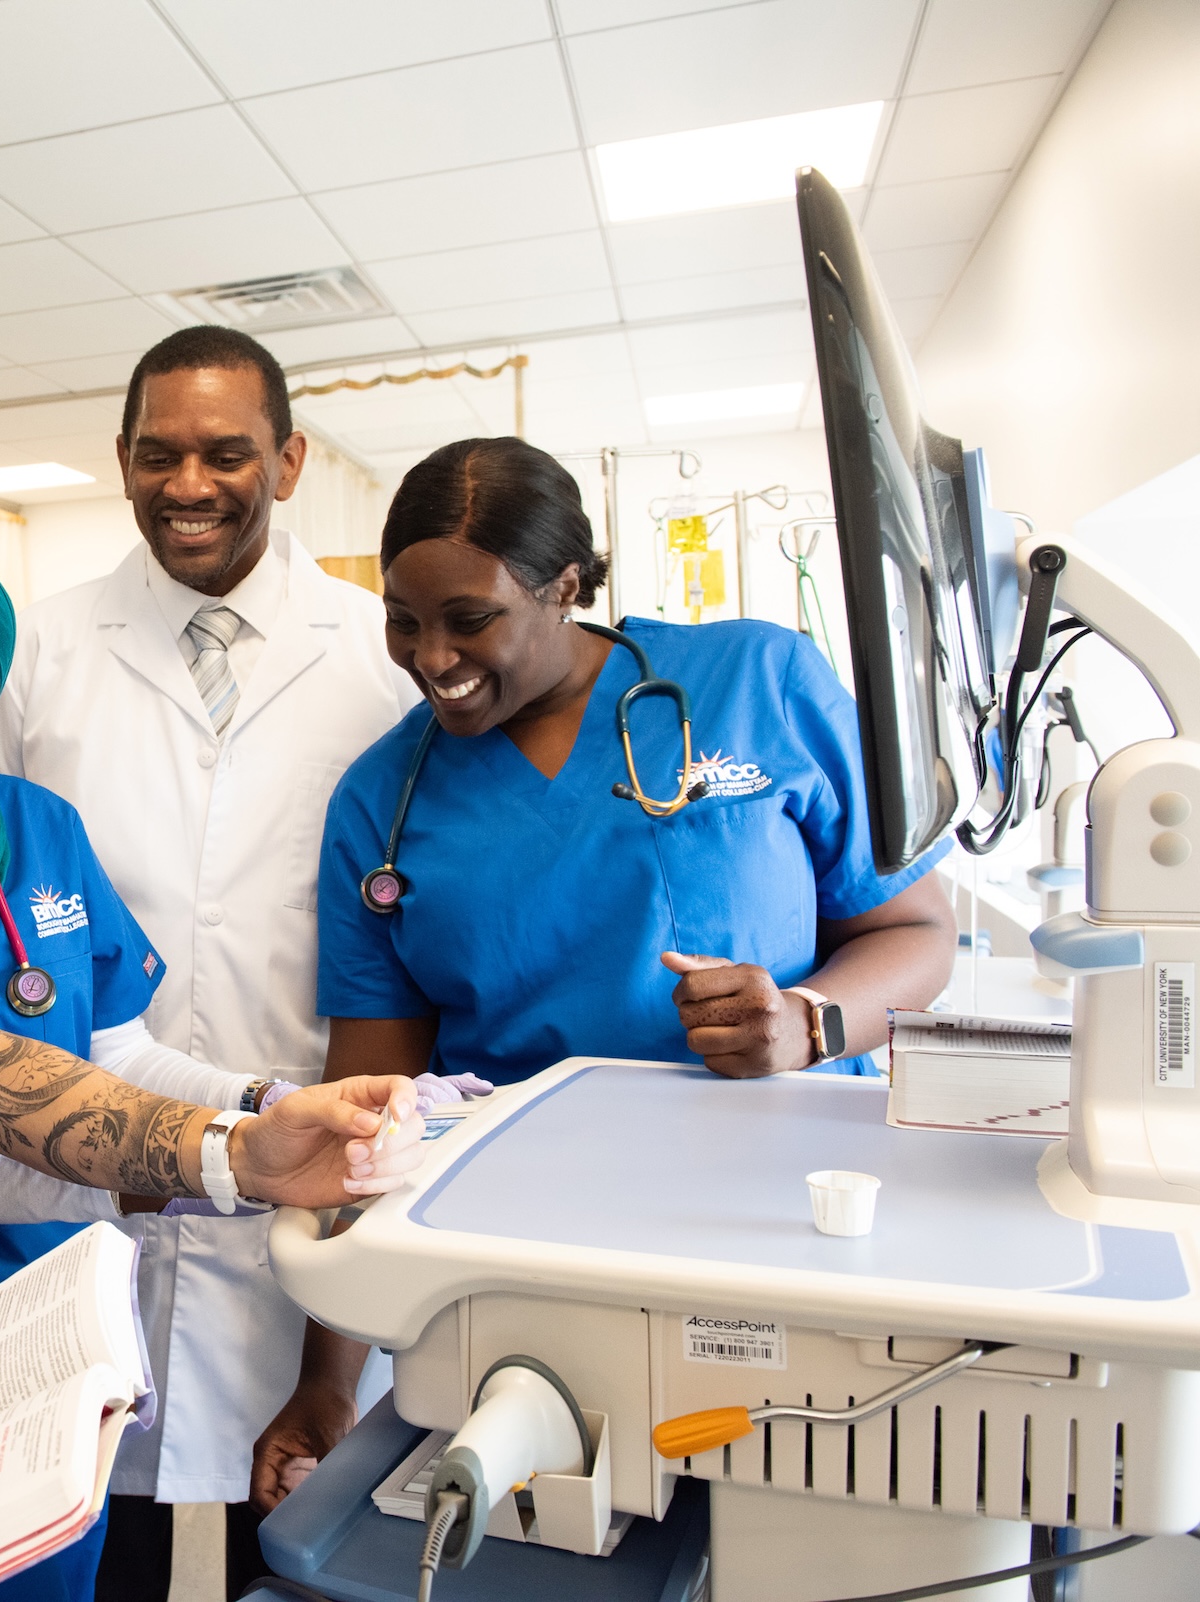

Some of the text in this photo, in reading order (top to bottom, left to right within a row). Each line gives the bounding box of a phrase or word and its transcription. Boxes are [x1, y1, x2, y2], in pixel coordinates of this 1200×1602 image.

[1159, 968, 1168, 1081] CITY UNIVERSITY OF NEW YORK
[686, 1315, 776, 1334] AccessPoint
[689, 1334, 720, 1342] SERVICE:
